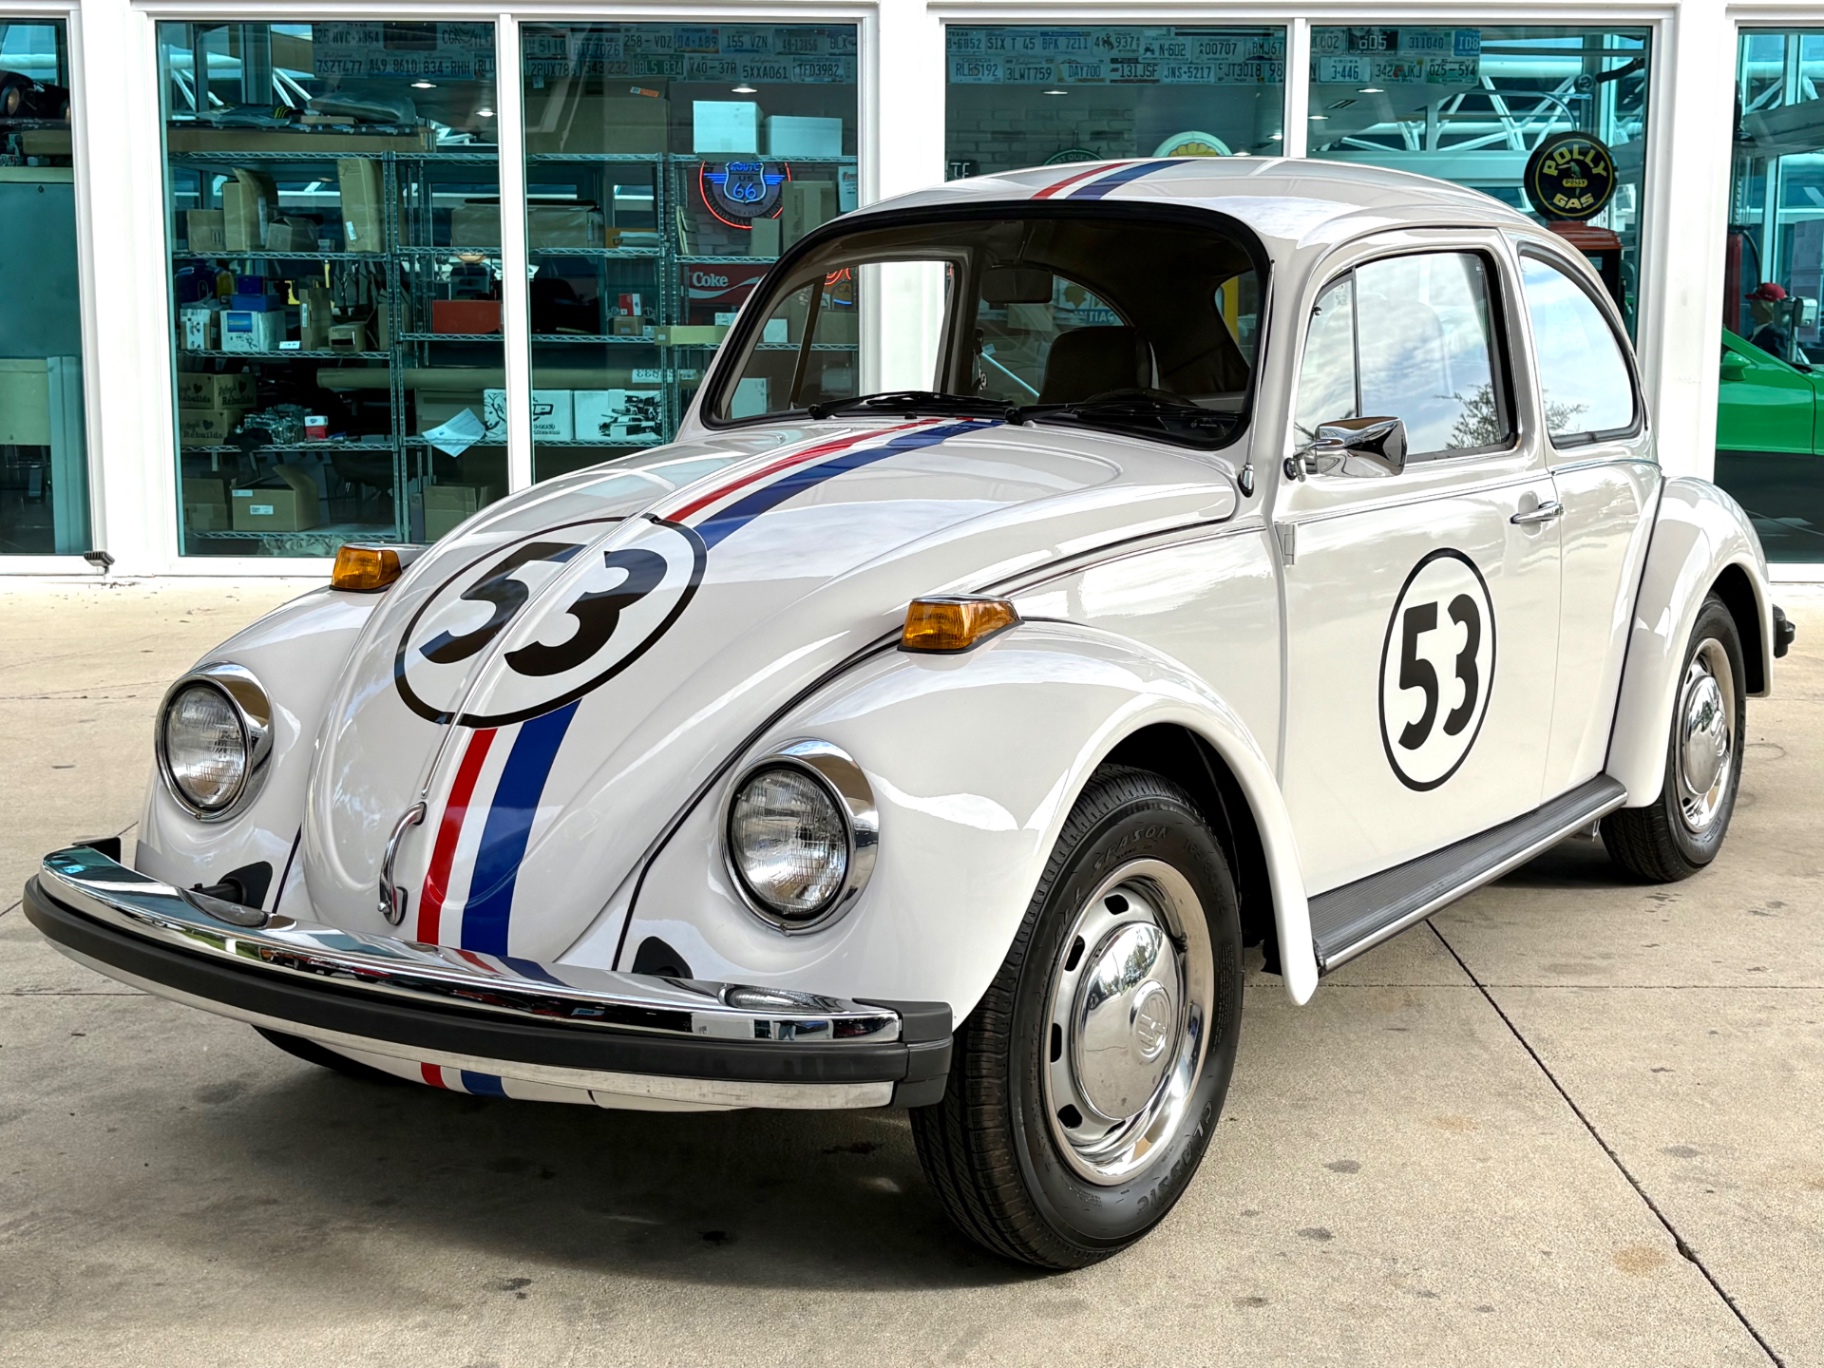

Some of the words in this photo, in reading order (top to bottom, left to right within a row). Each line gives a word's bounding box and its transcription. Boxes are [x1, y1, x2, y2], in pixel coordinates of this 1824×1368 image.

[987, 37, 1006, 50] SIX
[1011, 37, 1018, 50] T
[1023, 37, 1035, 51] 45
[1066, 37, 1089, 50] 7211
[742, 64, 789, 80] 5XXA061
[1006, 66, 1053, 81] 3LWT759
[1068, 64, 1101, 78] DAY700
[1164, 65, 1212, 80] JNS-5217
[1542, 144, 1608, 177] POLLY
[732, 182, 757, 199] 66
[1553, 193, 1595, 209] GAS
[692, 271, 729, 287] Coke
[418, 541, 668, 677] 53
[1397, 593, 1481, 751] 53
